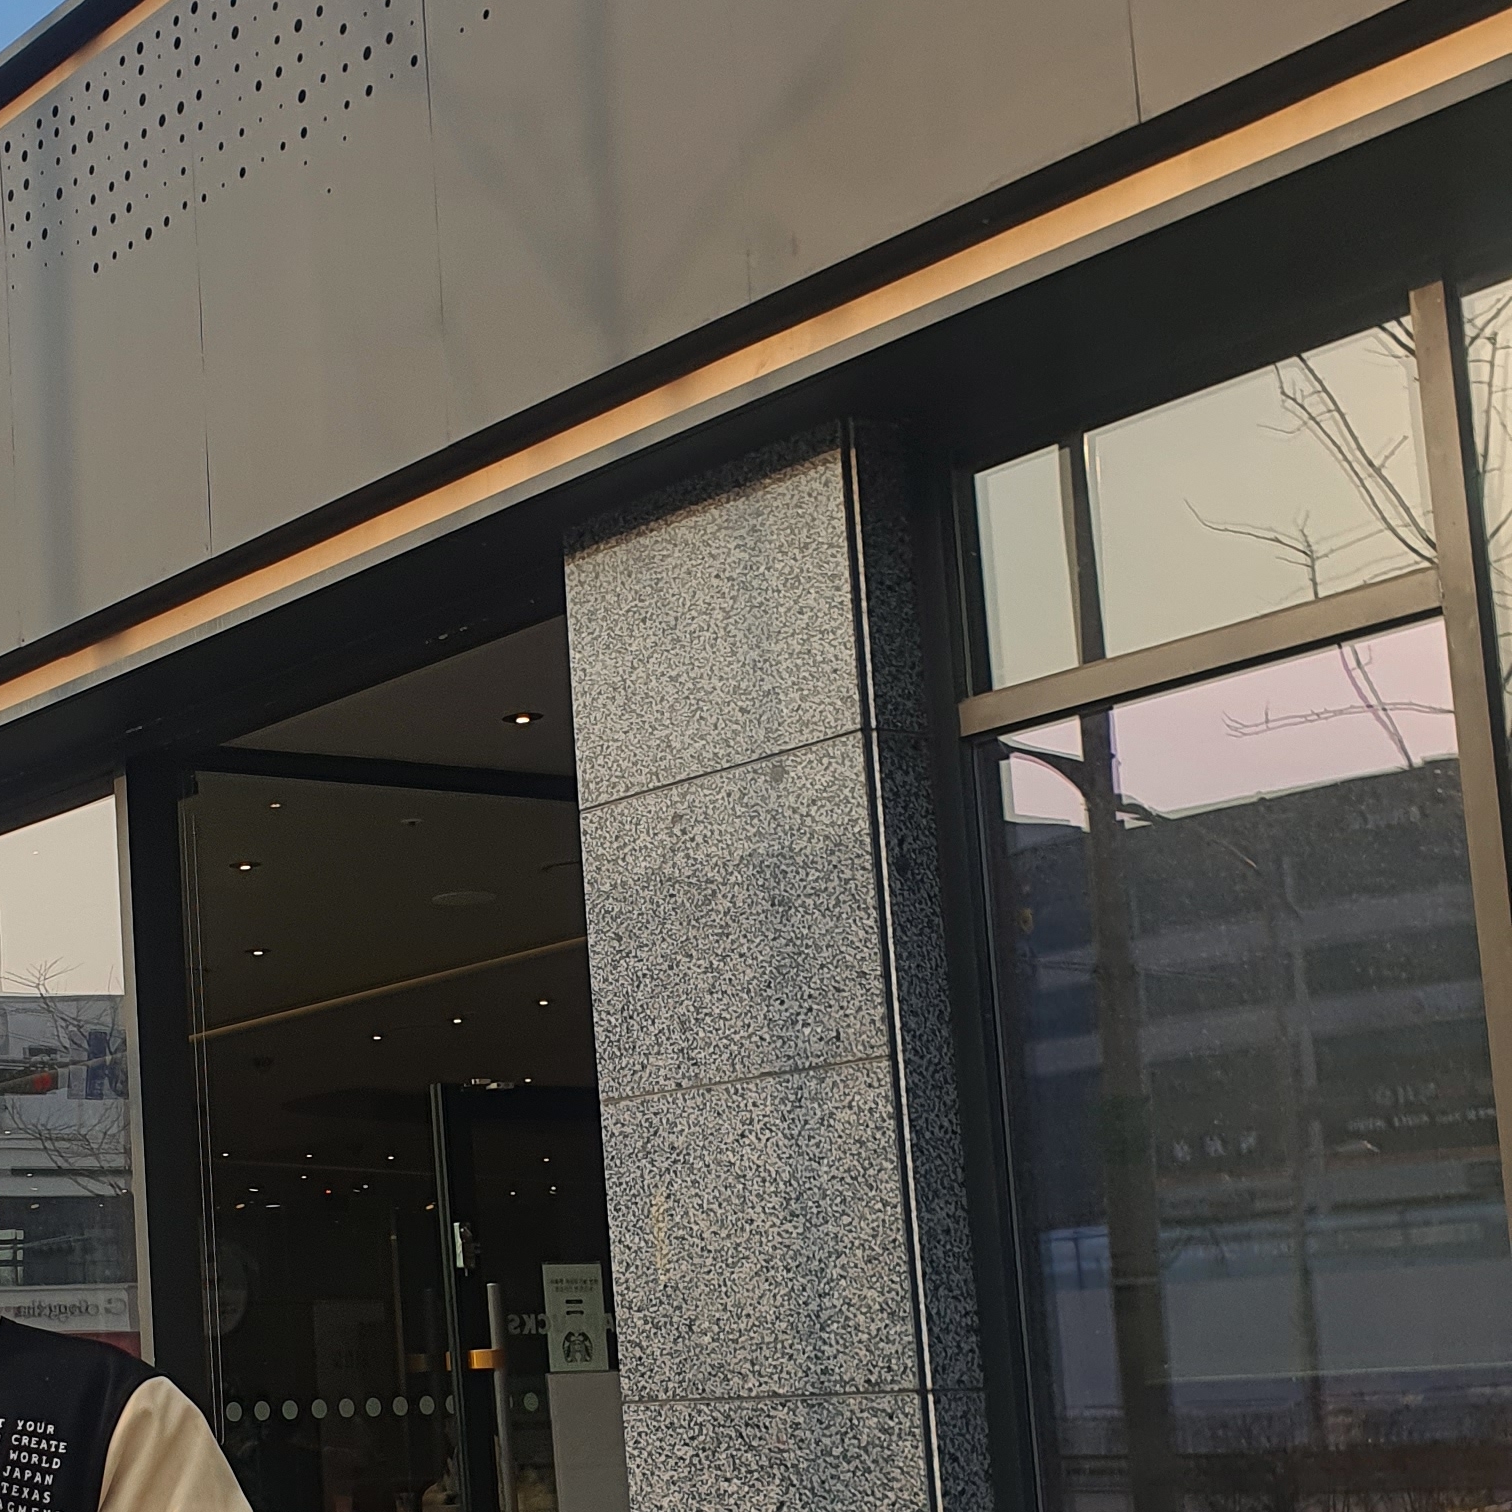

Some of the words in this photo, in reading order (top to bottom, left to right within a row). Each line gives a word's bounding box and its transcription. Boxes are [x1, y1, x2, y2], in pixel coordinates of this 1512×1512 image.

[16, 1419, 55, 1435] YOUR
[11, 1434, 68, 1453] CREATE
[9, 1449, 62, 1469] WORLD
[2, 1465, 54, 1486] JAPAN
[0, 1482, 52, 1504] TEXAS
